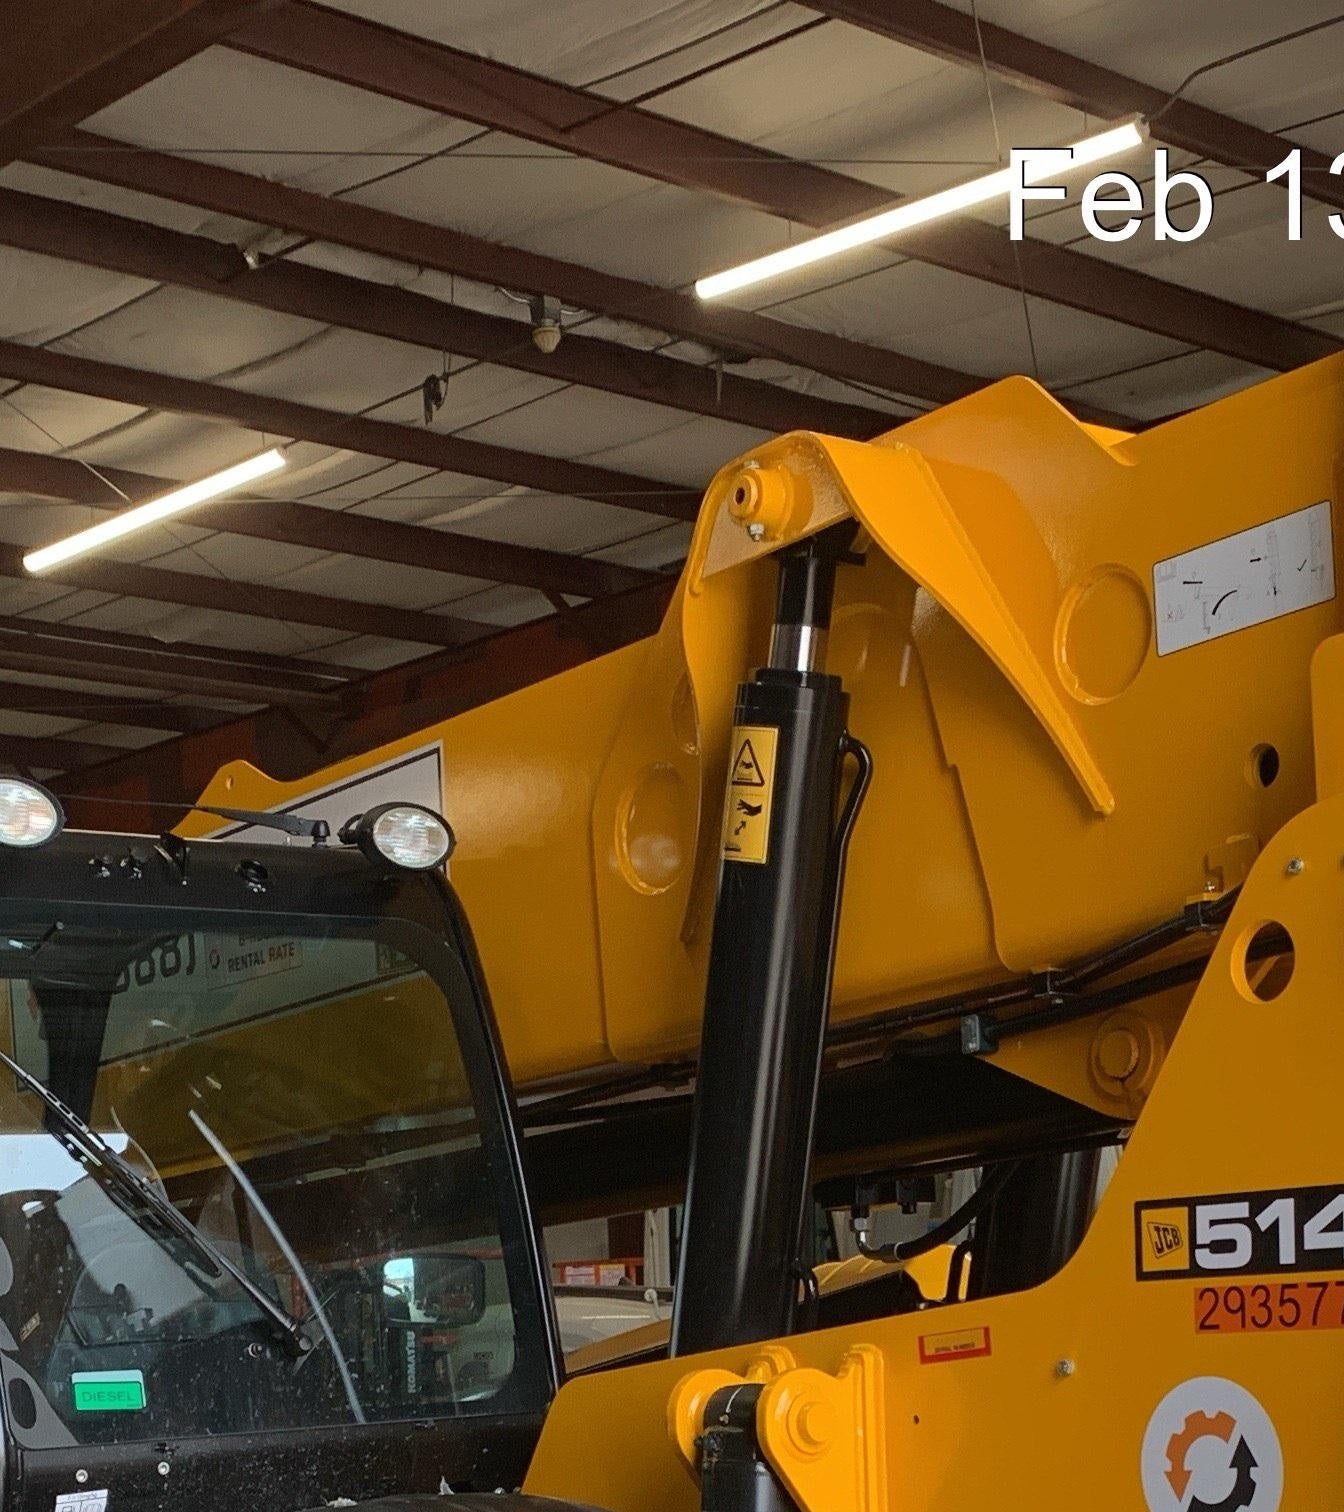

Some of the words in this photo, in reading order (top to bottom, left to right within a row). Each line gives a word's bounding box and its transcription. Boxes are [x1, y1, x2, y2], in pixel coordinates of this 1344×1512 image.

[227, 951, 266, 974] RENTAL
[268, 943, 296, 963] RATE
[1153, 1221, 1182, 1256] JCB
[81, 1390, 136, 1404] DIESEL
